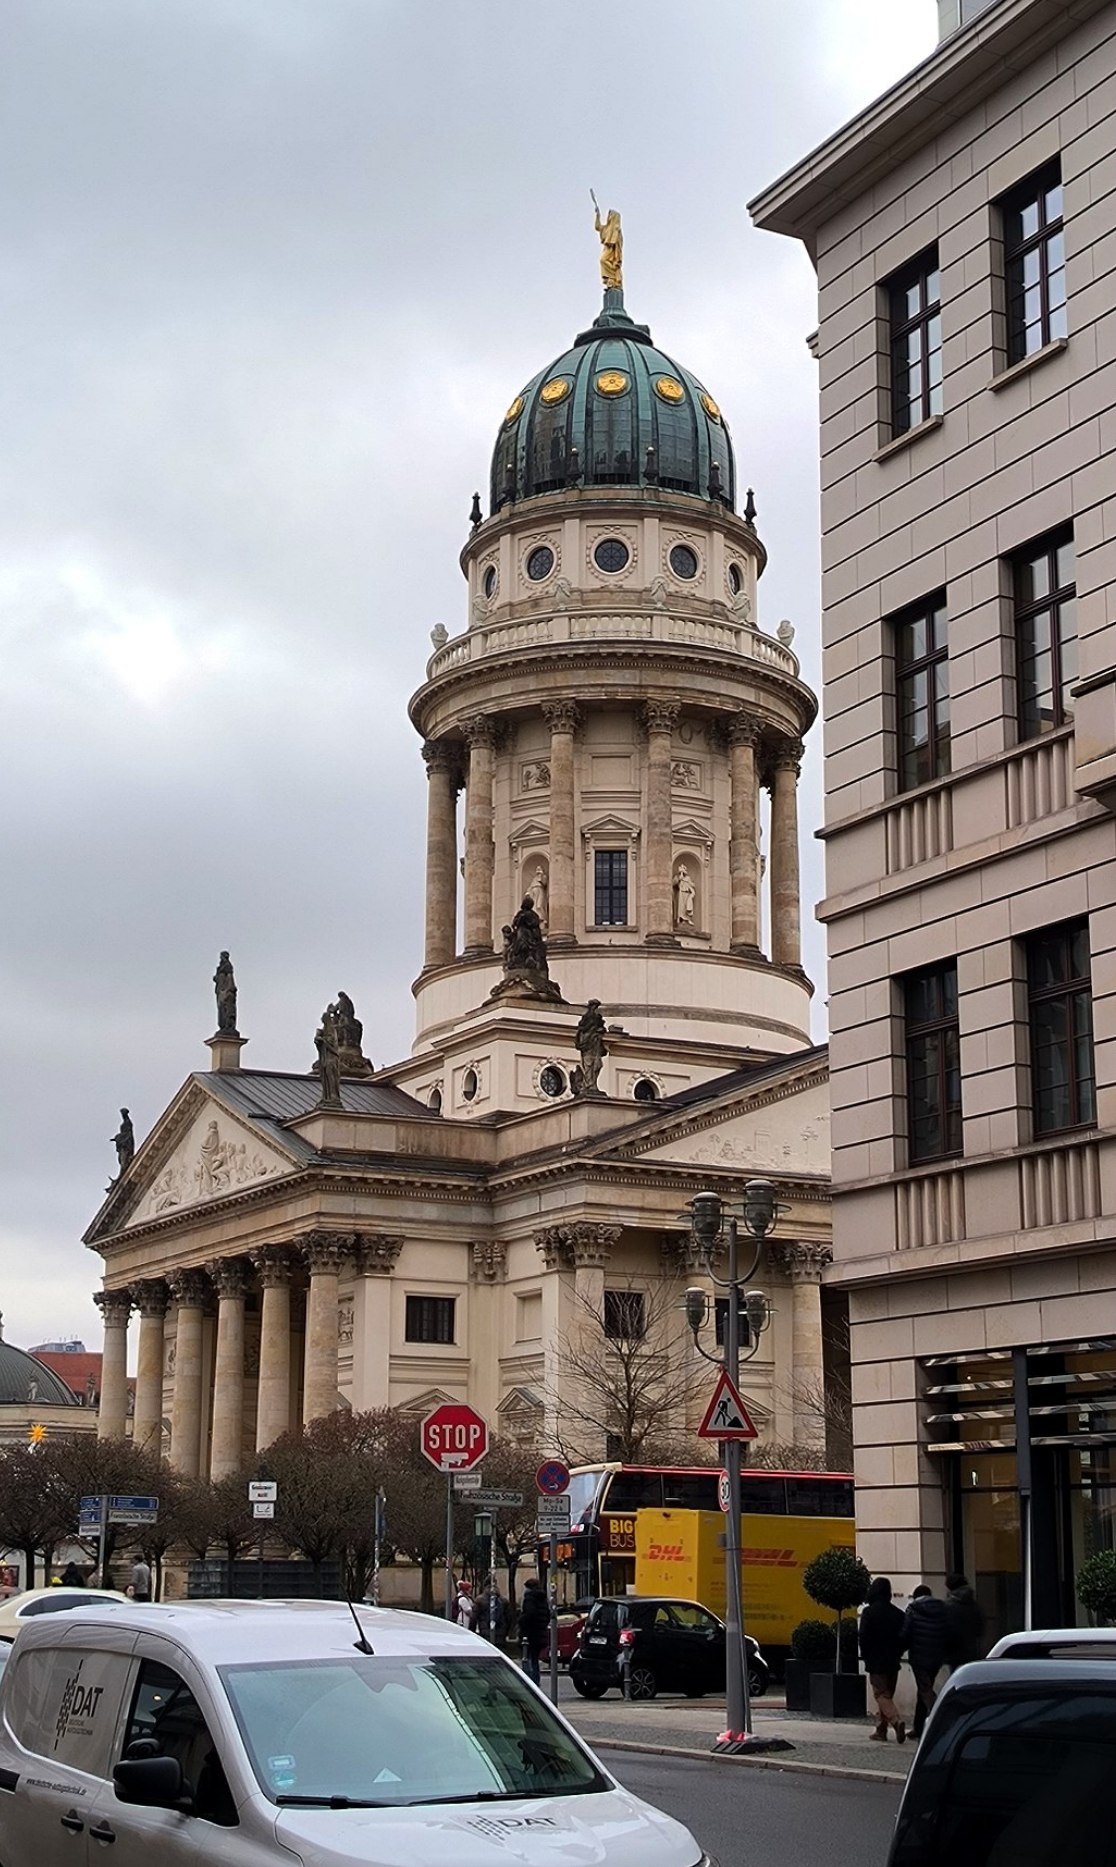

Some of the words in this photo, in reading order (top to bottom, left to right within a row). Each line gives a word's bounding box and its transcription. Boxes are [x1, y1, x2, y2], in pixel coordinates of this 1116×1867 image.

[428, 1424, 481, 1449] STOP
[721, 1481, 731, 1500] 30
[609, 1519, 634, 1534] BIG
[609, 1534, 635, 1548] BUS
[648, 1544, 685, 1562] DHL
[71, 1685, 104, 1718] DAT
[496, 1817, 557, 1828] DAT
